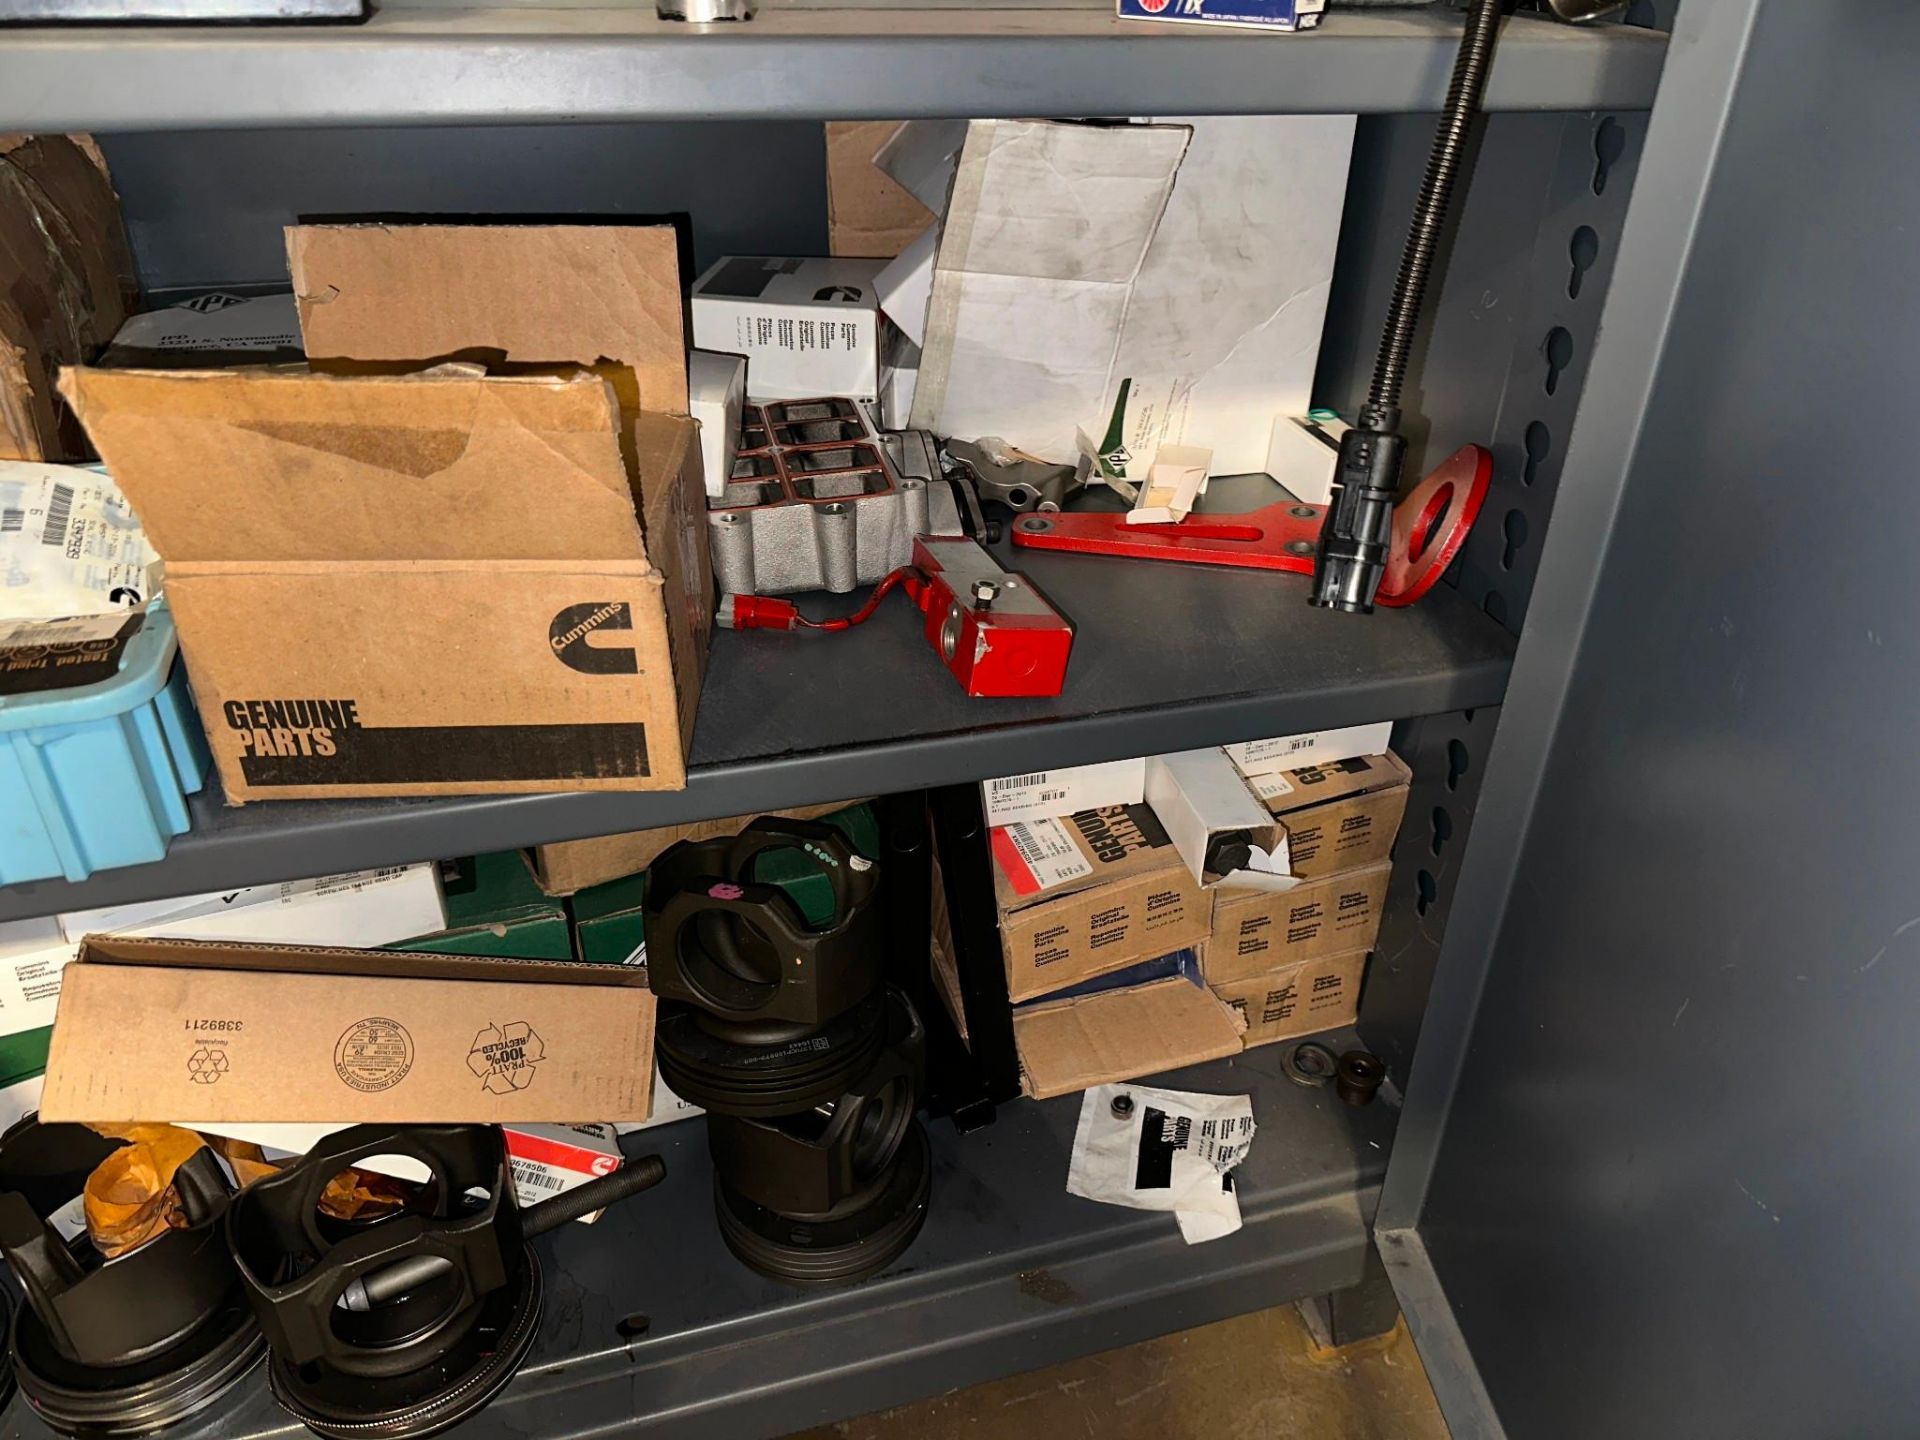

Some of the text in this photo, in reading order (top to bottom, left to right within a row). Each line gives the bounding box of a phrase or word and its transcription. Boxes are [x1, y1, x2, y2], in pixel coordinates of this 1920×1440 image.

[550, 600, 622, 651] Cummins
[223, 699, 362, 731] GENUINE
[238, 727, 337, 757] PARTS
[1070, 812, 1128, 864] GENUI
[1034, 939, 1054, 948] Parts
[185, 1019, 244, 1031] 3389211
[482, 1037, 527, 1054] RECYCLED
[485, 1046, 526, 1066] 100%
[337, 1062, 346, 1077] USA
[391, 1064, 410, 1083] PRATT
[491, 1060, 525, 1075] PRATT
[346, 1077, 389, 1090] INDUSTRIES
[1173, 1116, 1192, 1151] GENUINE
